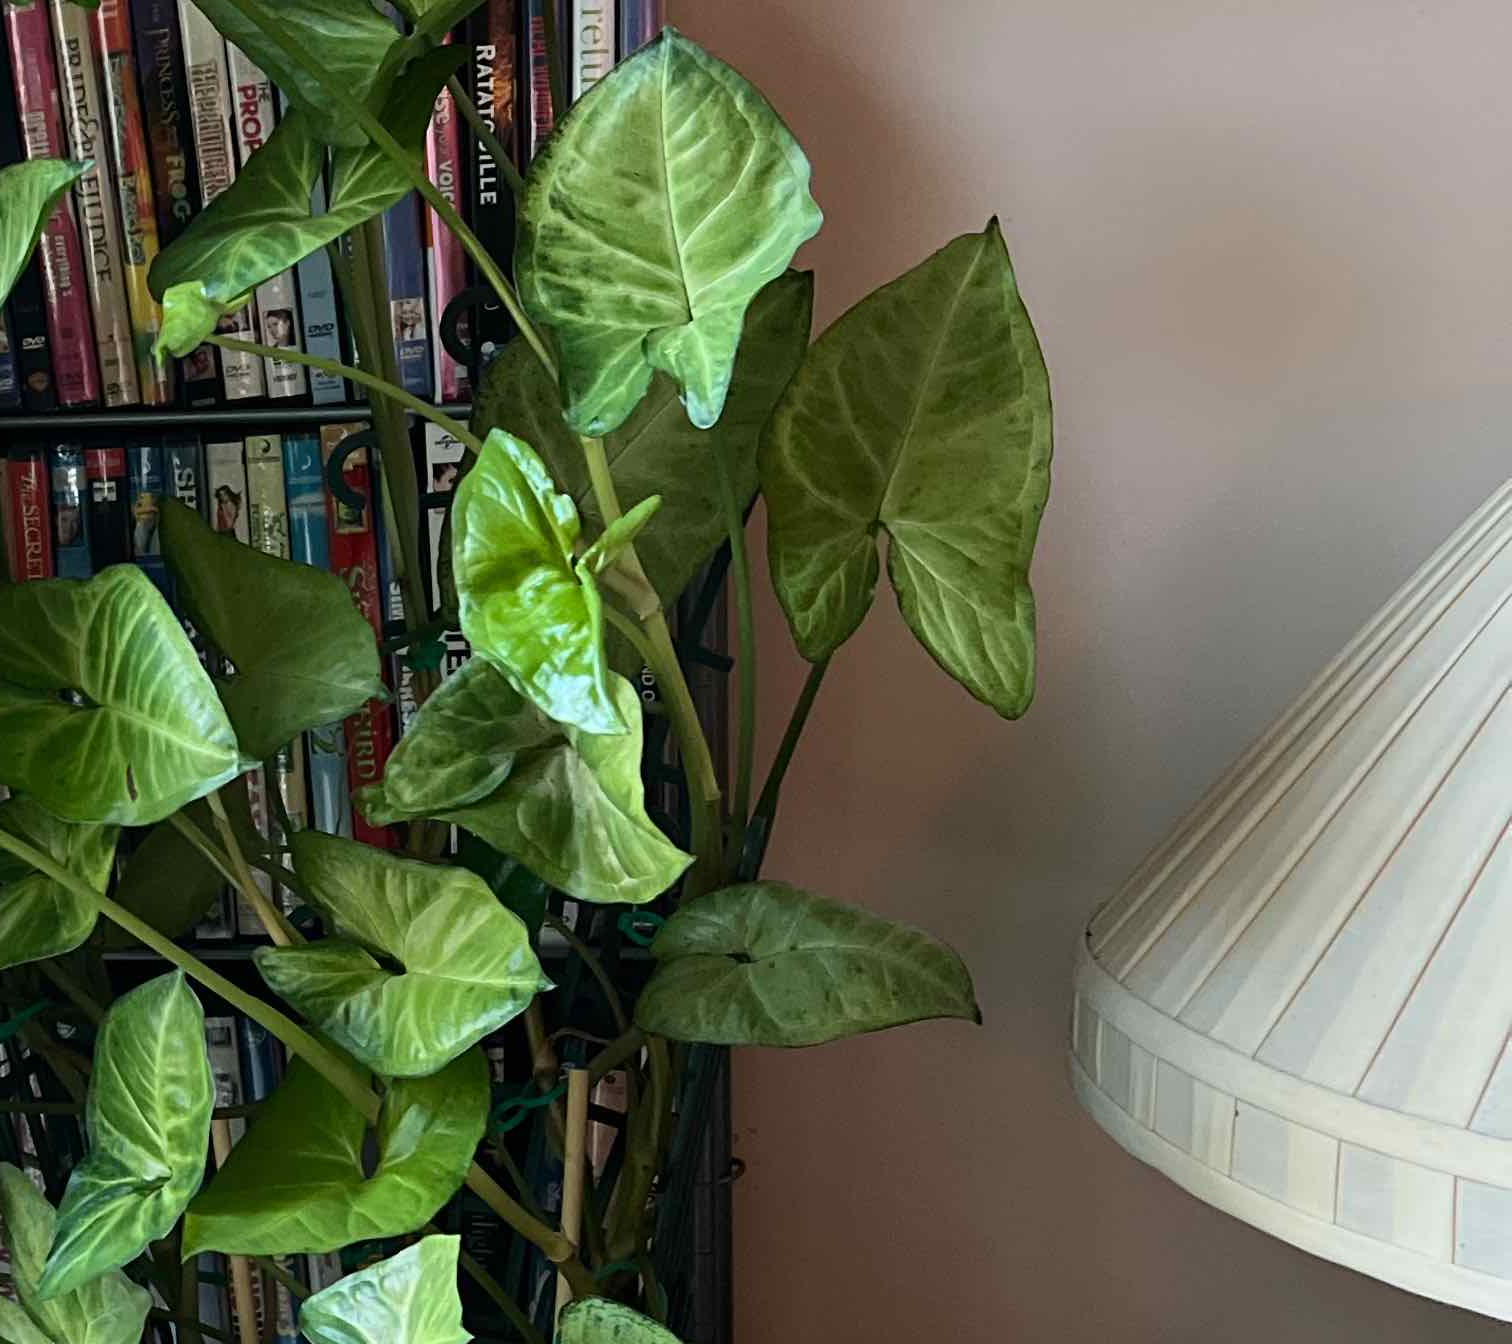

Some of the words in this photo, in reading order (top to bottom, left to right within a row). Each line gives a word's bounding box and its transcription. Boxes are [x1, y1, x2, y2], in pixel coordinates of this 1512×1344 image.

[581, 7, 609, 83] retu
[143, 27, 181, 126] PRINCESS
[165, 153, 191, 223] FROG
[238, 85, 263, 154] PROP
[258, 81, 270, 103] THE
[25, 111, 51, 160] prett
[439, 160, 455, 208] VOIC
[22, 504, 44, 580] SECRET
